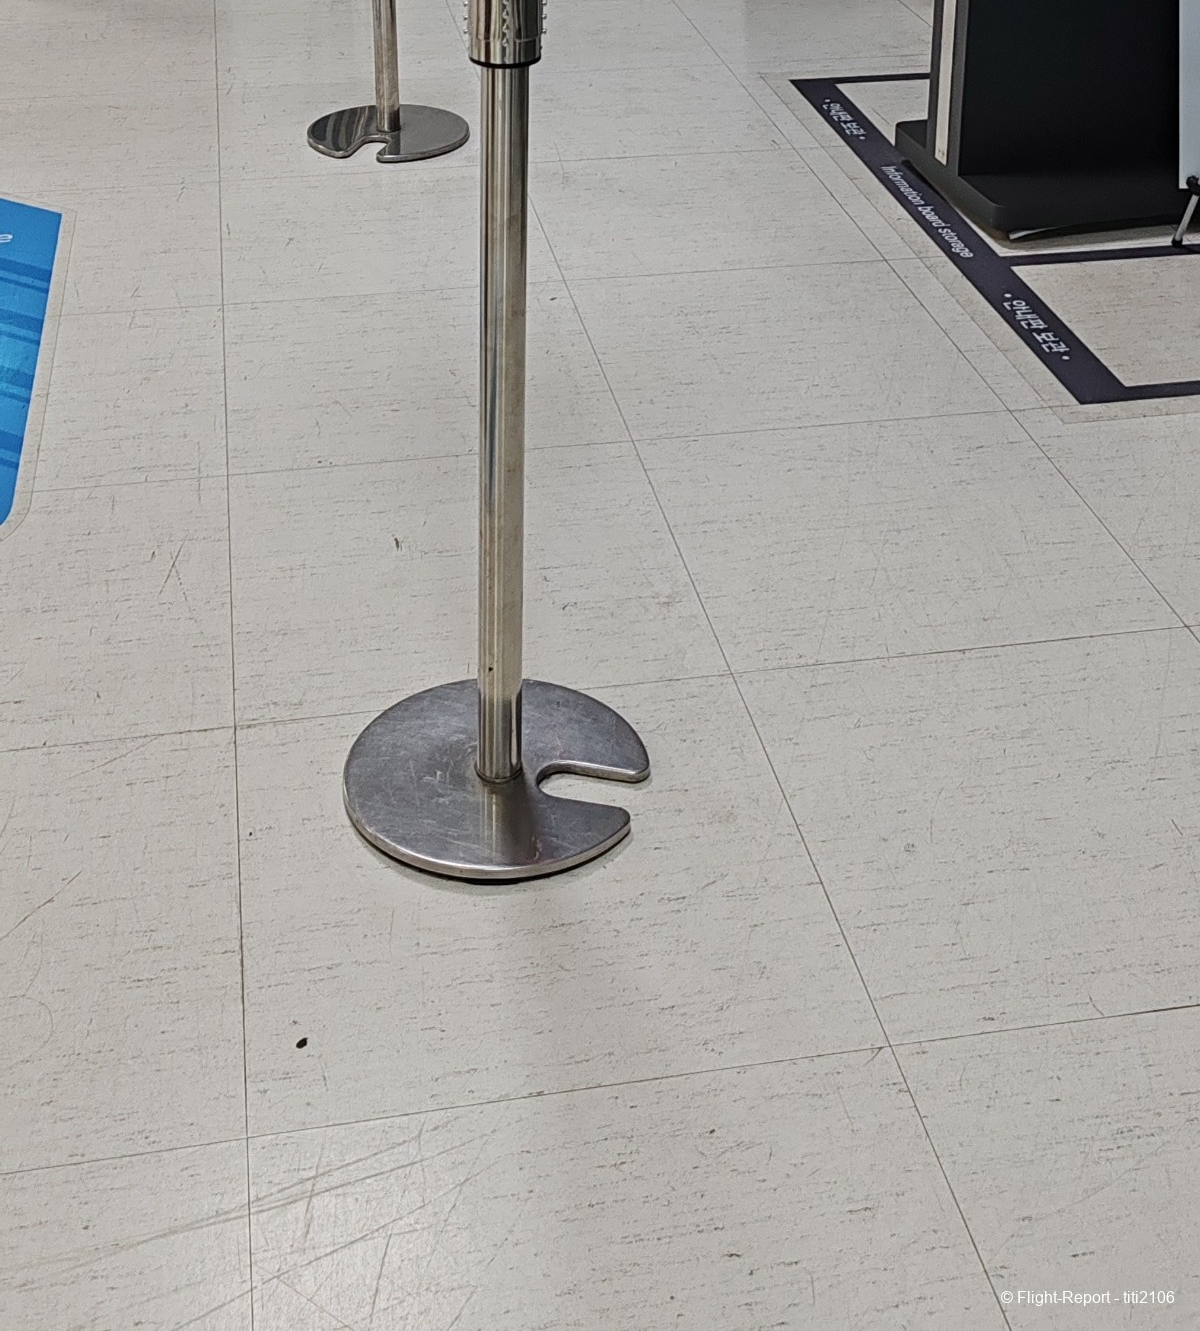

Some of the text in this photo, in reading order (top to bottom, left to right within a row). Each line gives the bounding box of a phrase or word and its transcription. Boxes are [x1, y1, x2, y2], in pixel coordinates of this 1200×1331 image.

[822, 102, 867, 136] 안내판 보관
[881, 165, 974, 258] Information board storage
[1003, 299, 1071, 353] 안내판 보관
